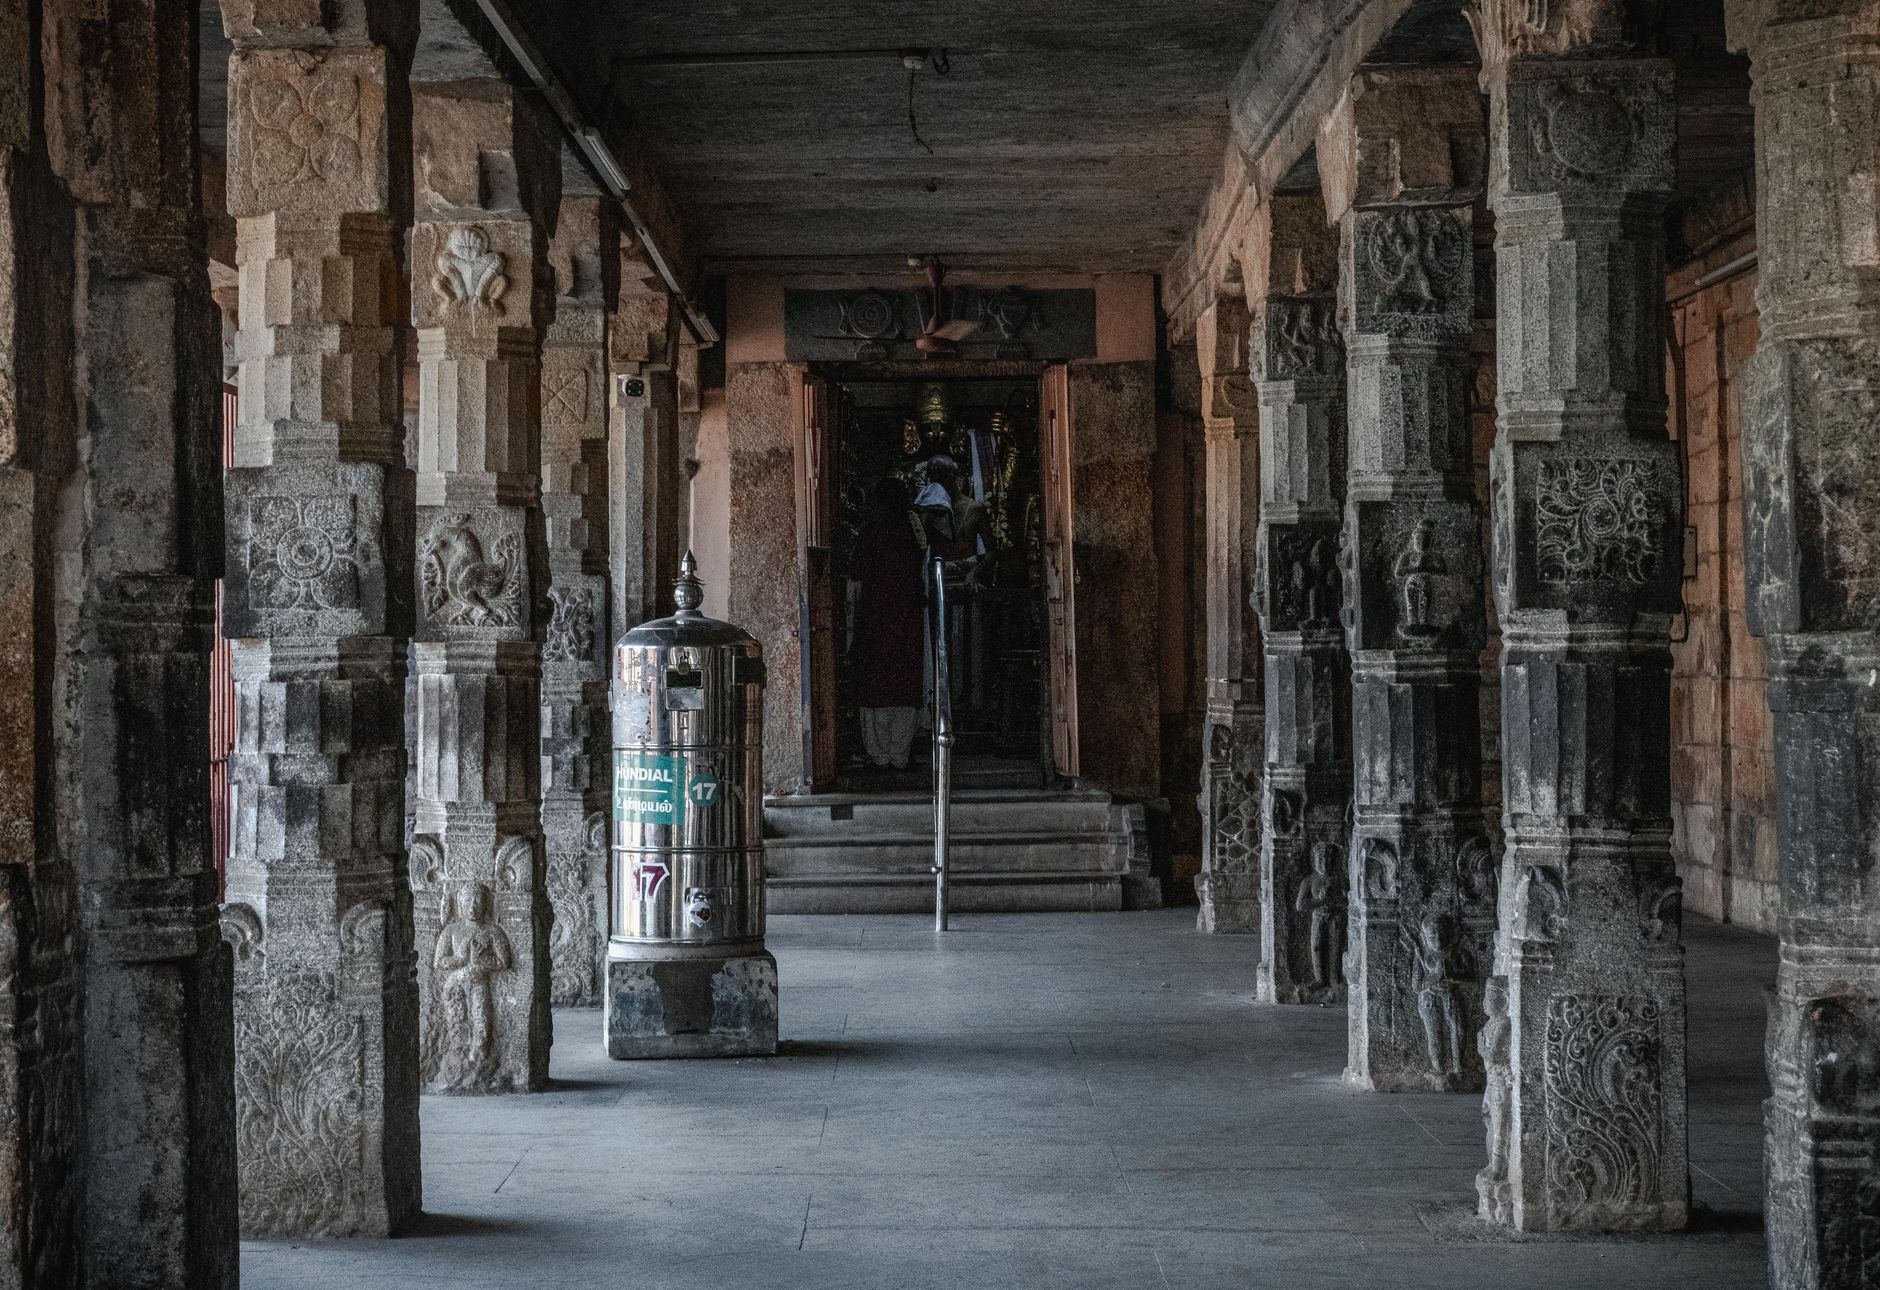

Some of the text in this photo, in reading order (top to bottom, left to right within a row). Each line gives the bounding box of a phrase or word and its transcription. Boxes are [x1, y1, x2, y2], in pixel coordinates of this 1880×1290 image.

[617, 767, 672, 782] HUNDIAL
[692, 782, 717, 800] 17
[633, 863, 669, 902] 17
